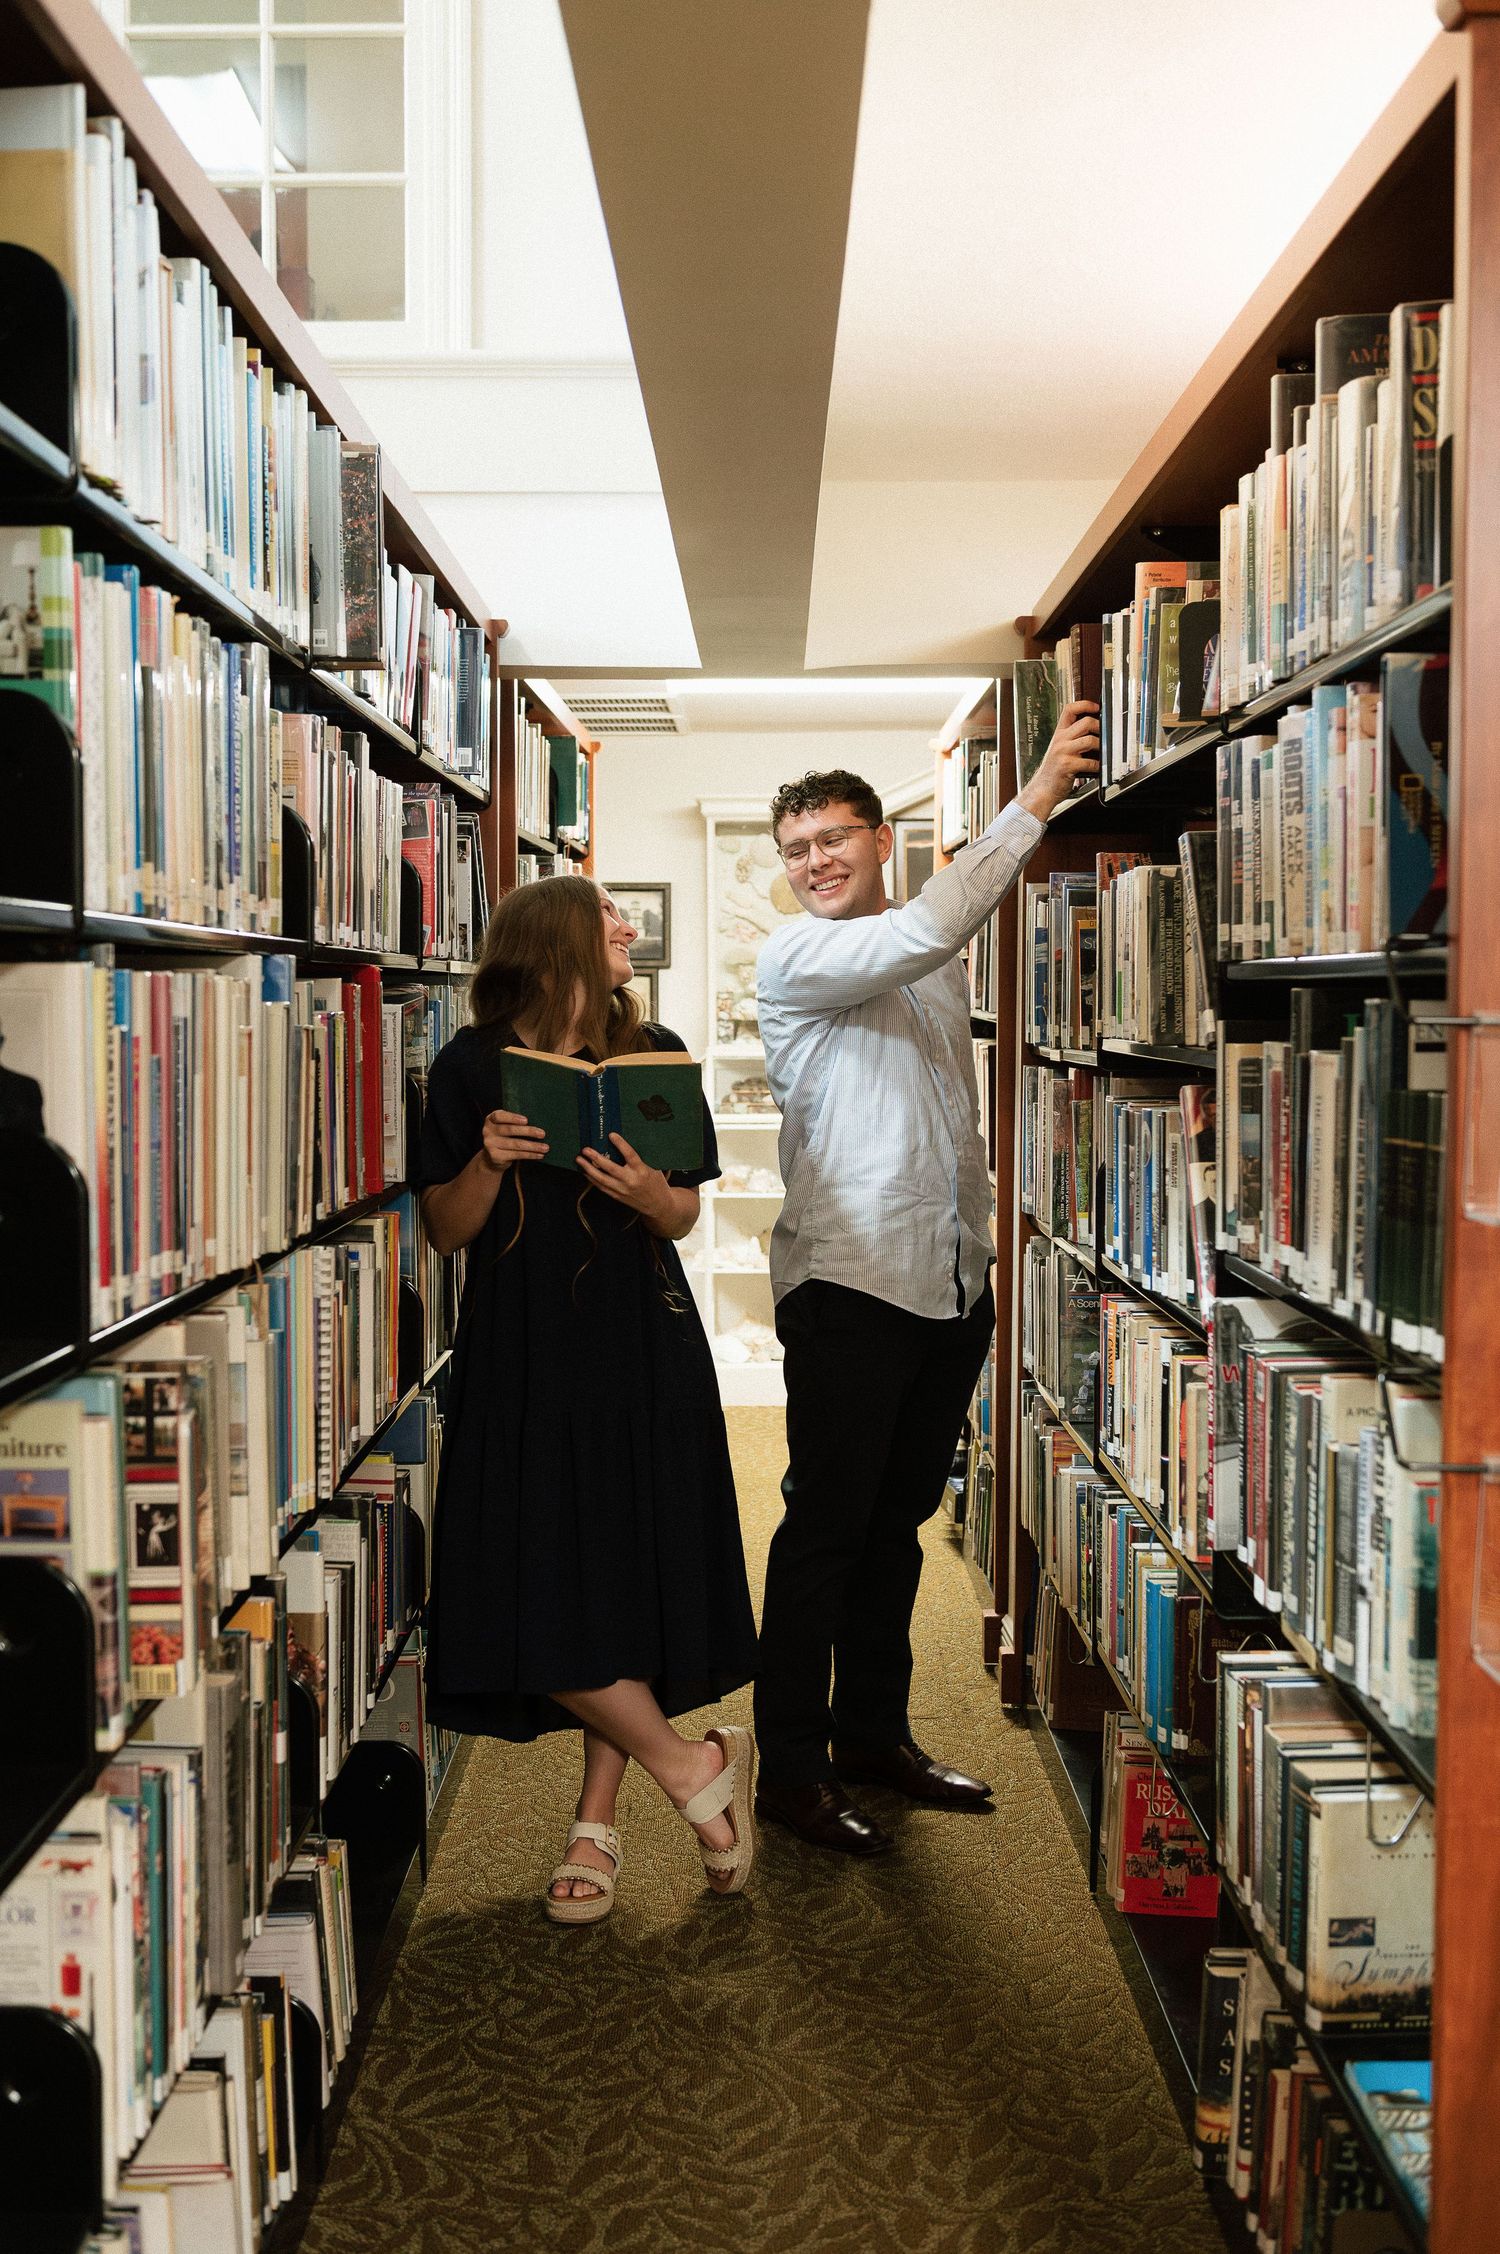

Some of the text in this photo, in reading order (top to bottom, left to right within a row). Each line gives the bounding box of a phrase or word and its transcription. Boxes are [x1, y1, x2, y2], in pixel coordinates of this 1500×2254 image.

[1284, 737, 1304, 875] ROOTS ALEX
[1286, 825, 1296, 889] HALEY
[1174, 880, 1184, 901] MORE
[1166, 918, 1174, 937] FIFTH
[1174, 902, 1184, 922] THAN
[1279, 1096, 1291, 1243] Time Detectives
[1068, 1299, 1076, 1308] A
[1107, 1338, 1115, 1384] CANYON
[1207, 1331, 1215, 1387] WORLD
[1207, 1389, 1215, 1422] WAR
